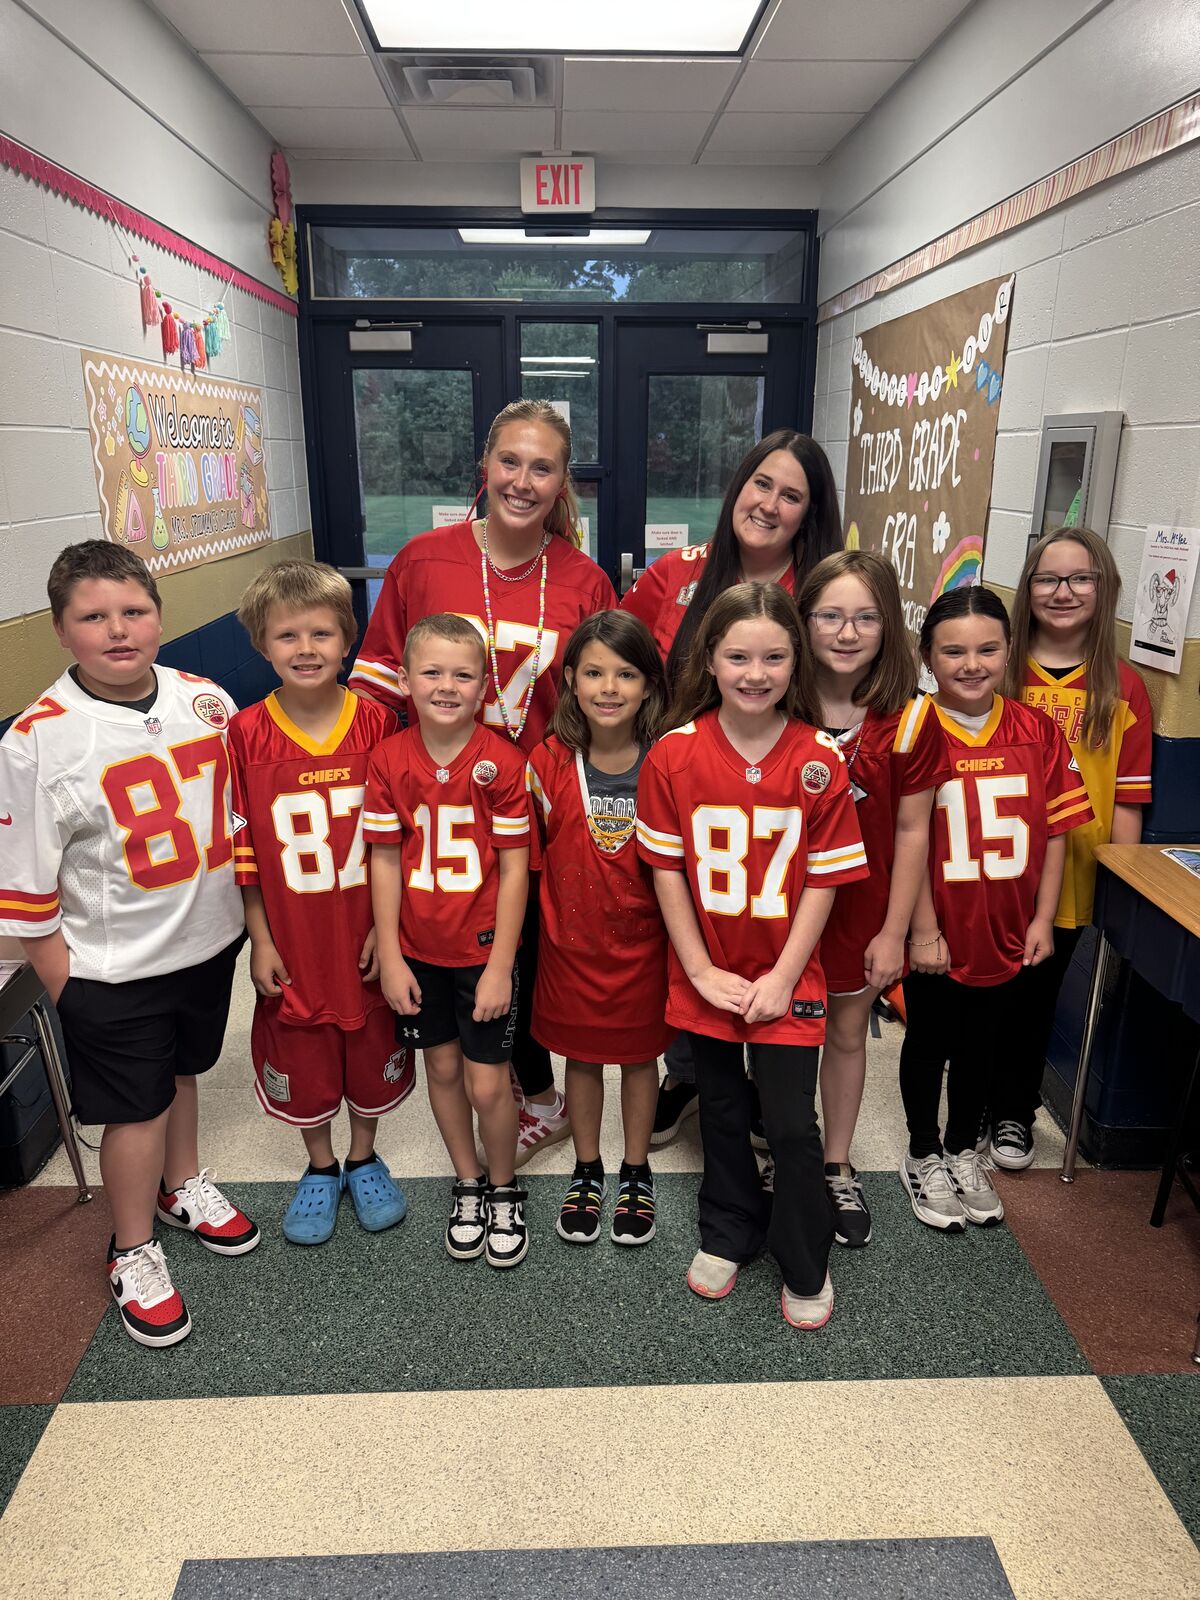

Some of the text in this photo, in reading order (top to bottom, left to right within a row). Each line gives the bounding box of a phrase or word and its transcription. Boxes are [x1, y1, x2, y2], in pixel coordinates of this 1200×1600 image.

[535, 164, 583, 205] EXIT
[148, 393, 235, 449] Welcome to
[920, 372, 941, 401] TO
[155, 451, 240, 509] THIRD GRADE
[860, 408, 968, 495] THIRD GRADE
[881, 511, 917, 590] ERA
[445, 612, 560, 728] 7
[1028, 692, 1059, 704] SAS
[298, 767, 351, 786] CHIEFS
[955, 757, 1005, 772] CHIEFS
[99, 731, 235, 893] 87
[270, 784, 368, 895] 87
[407, 803, 484, 894] 15
[935, 773, 1030, 883] 15
[690, 803, 803, 919] 87
